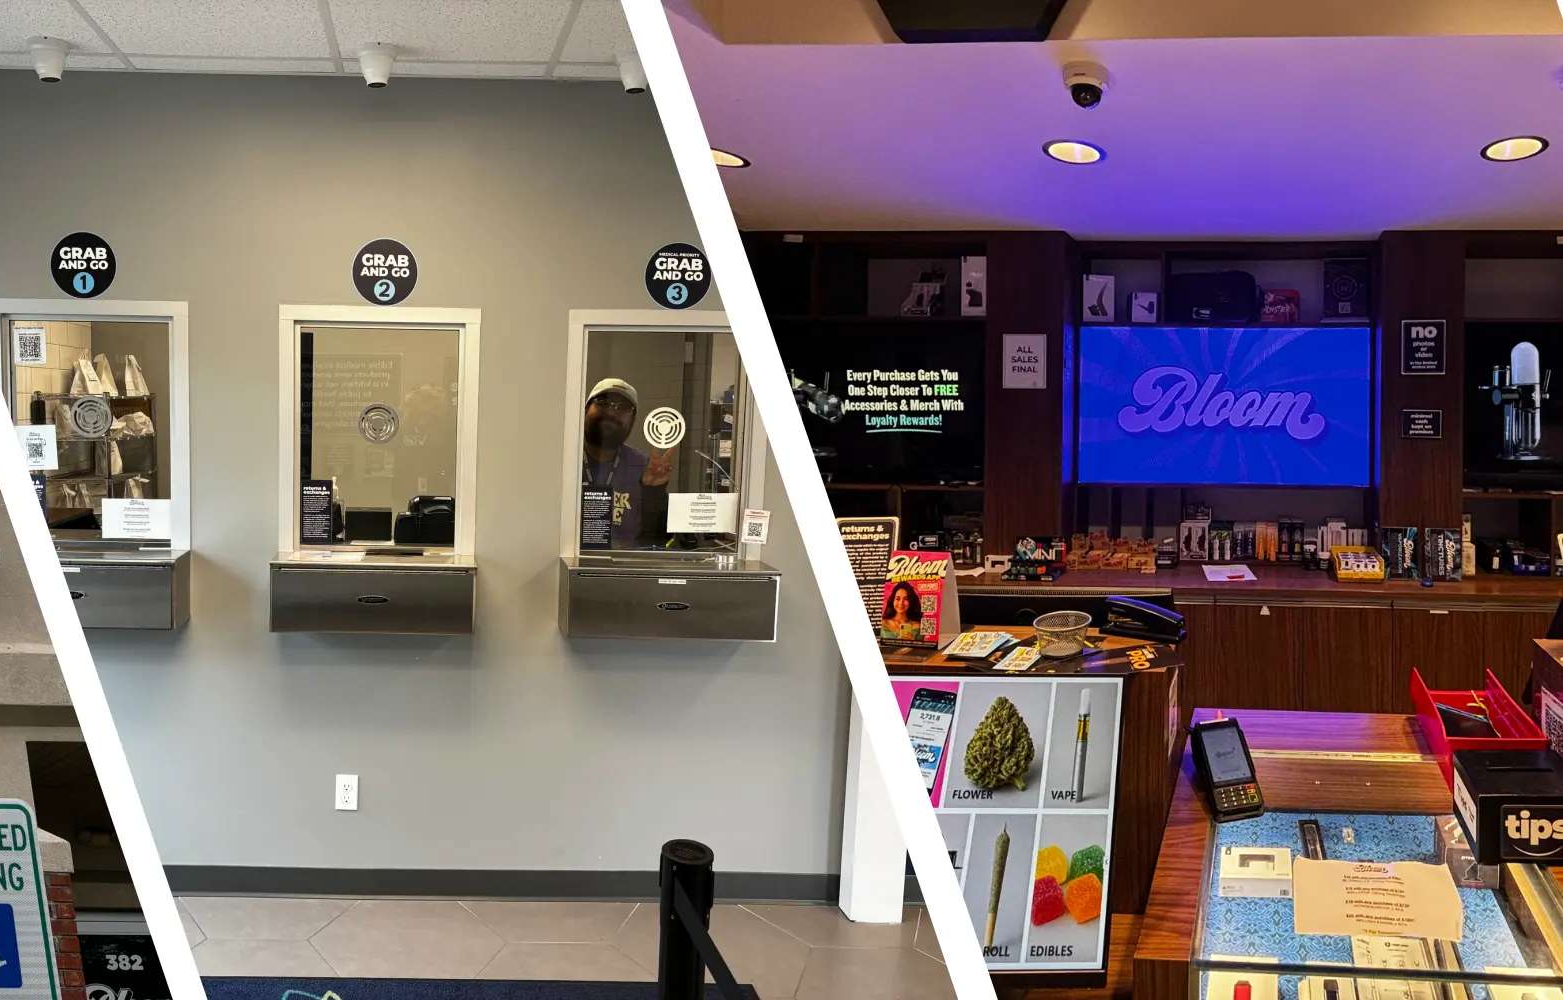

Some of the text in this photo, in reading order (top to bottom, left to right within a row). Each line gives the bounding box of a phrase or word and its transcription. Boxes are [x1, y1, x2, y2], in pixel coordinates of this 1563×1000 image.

[59, 247, 108, 260] GRAB
[362, 253, 410, 267] GRAB
[59, 260, 108, 270] AND GO
[655, 257, 703, 270] GRAB
[360, 267, 410, 278] AND GO
[653, 271, 704, 281] AND GO
[80, 274, 88, 290] 1
[378, 281, 390, 297] 2
[671, 286, 683, 301] 3
[1411, 326, 1437, 338] no
[846, 369, 958, 383] Every Purchase Gets You
[848, 384, 959, 398] One Step Closer To FREE
[844, 399, 964, 411] Accessories & Merch With
[1118, 366, 1326, 440] Bloom
[865, 414, 942, 428] Loyalty Rewards!
[842, 533, 890, 541] exchanges
[1403, 538, 1414, 569] Bloom
[886, 555, 948, 580] Bloom
[952, 789, 993, 800] FLOWER
[1051, 790, 1076, 800] VAPE
[1504, 810, 1563, 845] tips
[1030, 945, 1073, 957] EDIBLES
[105, 954, 144, 970] 382
